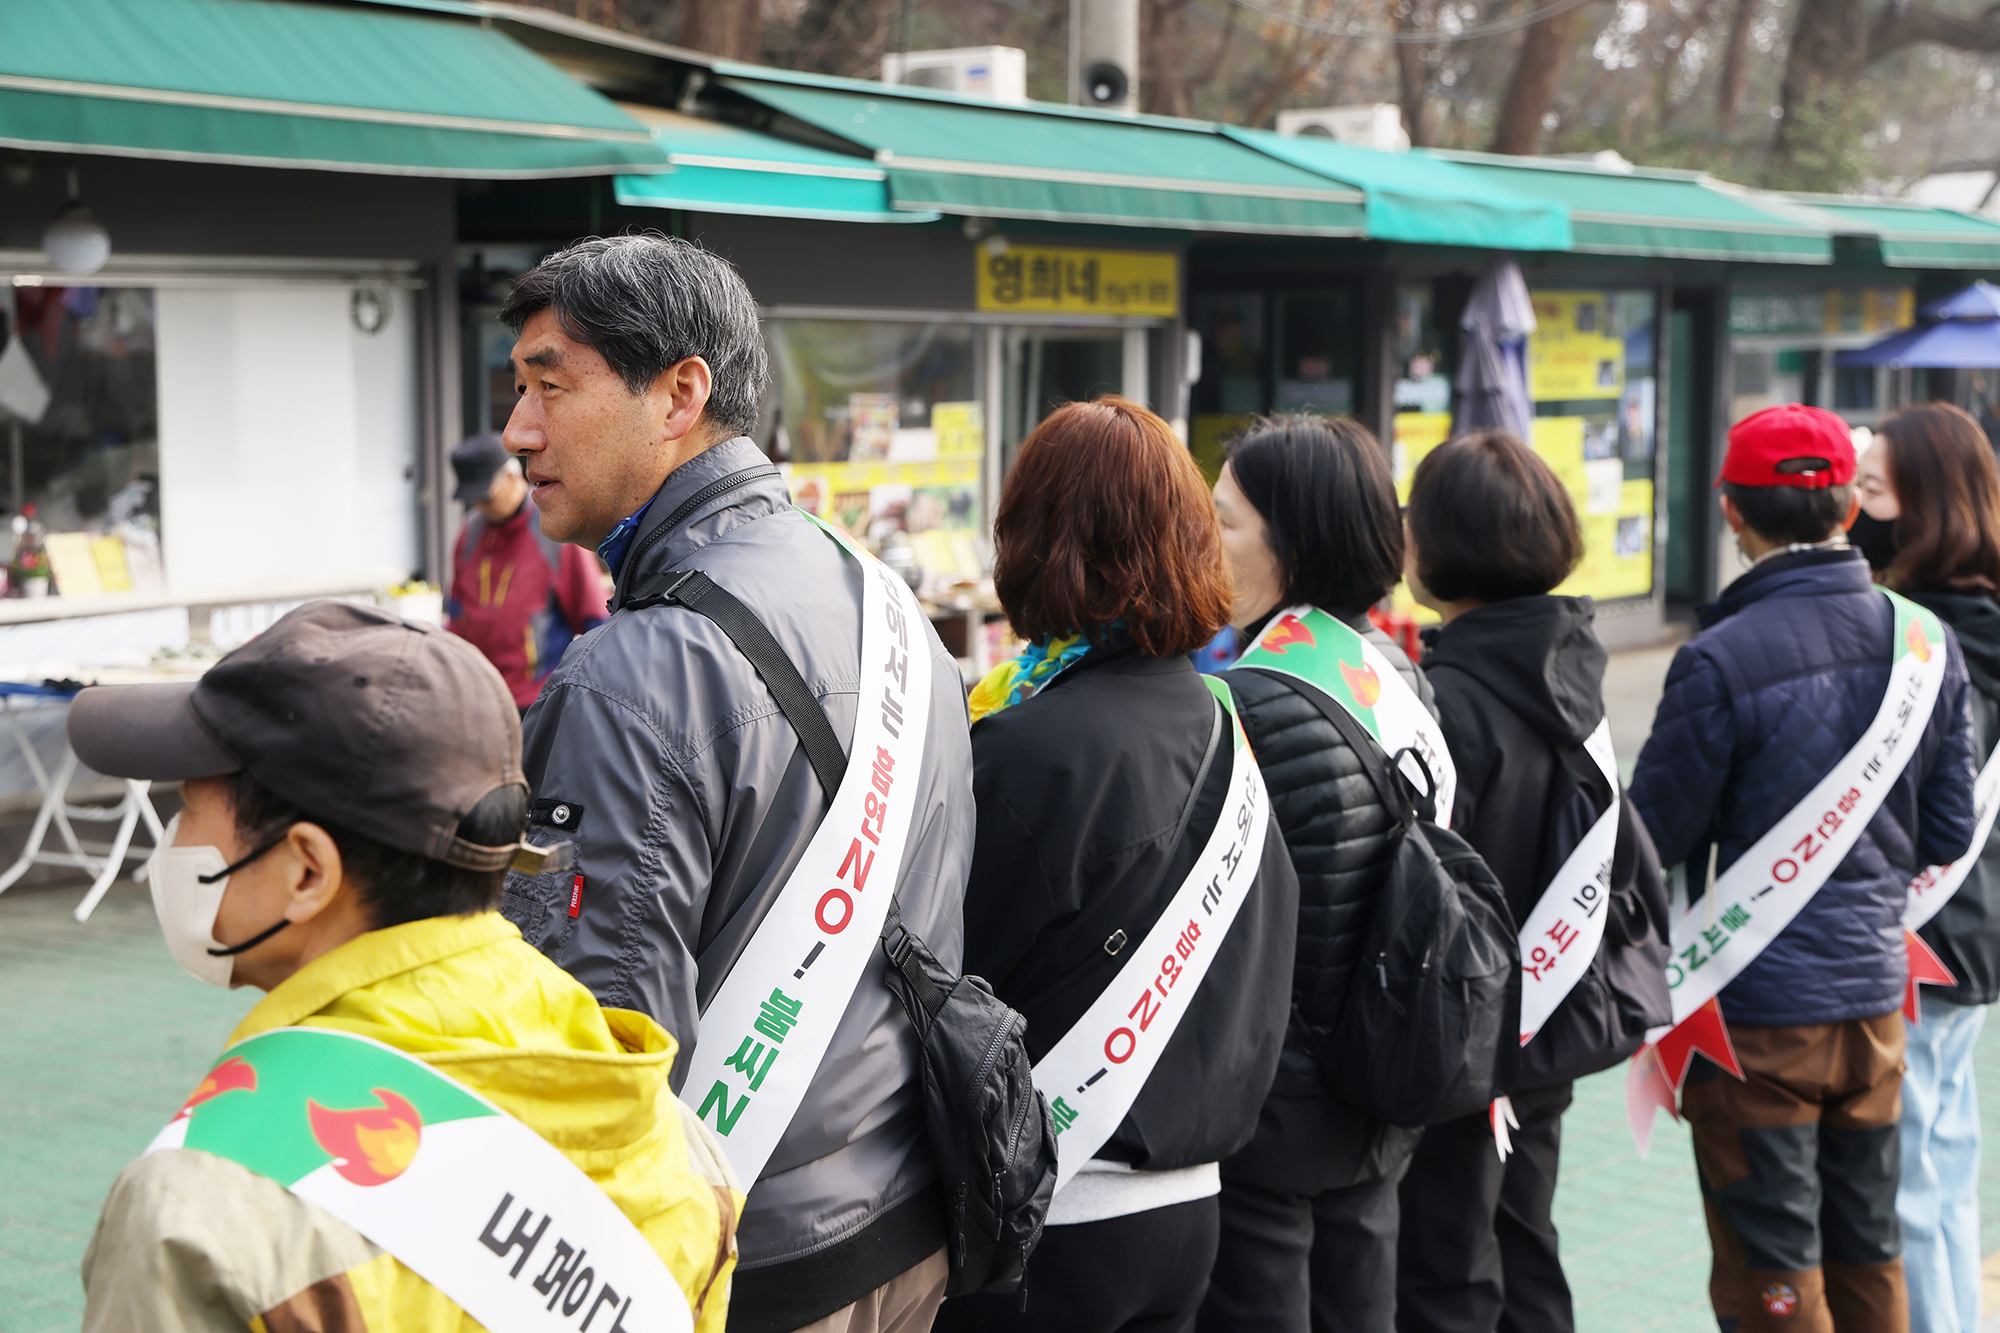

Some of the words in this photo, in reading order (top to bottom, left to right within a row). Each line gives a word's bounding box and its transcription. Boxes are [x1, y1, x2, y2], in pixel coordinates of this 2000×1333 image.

[988, 254, 1099, 304] 영희네
[1522, 917, 1581, 982] 씨앗
[696, 987, 803, 1138] 불씨N
